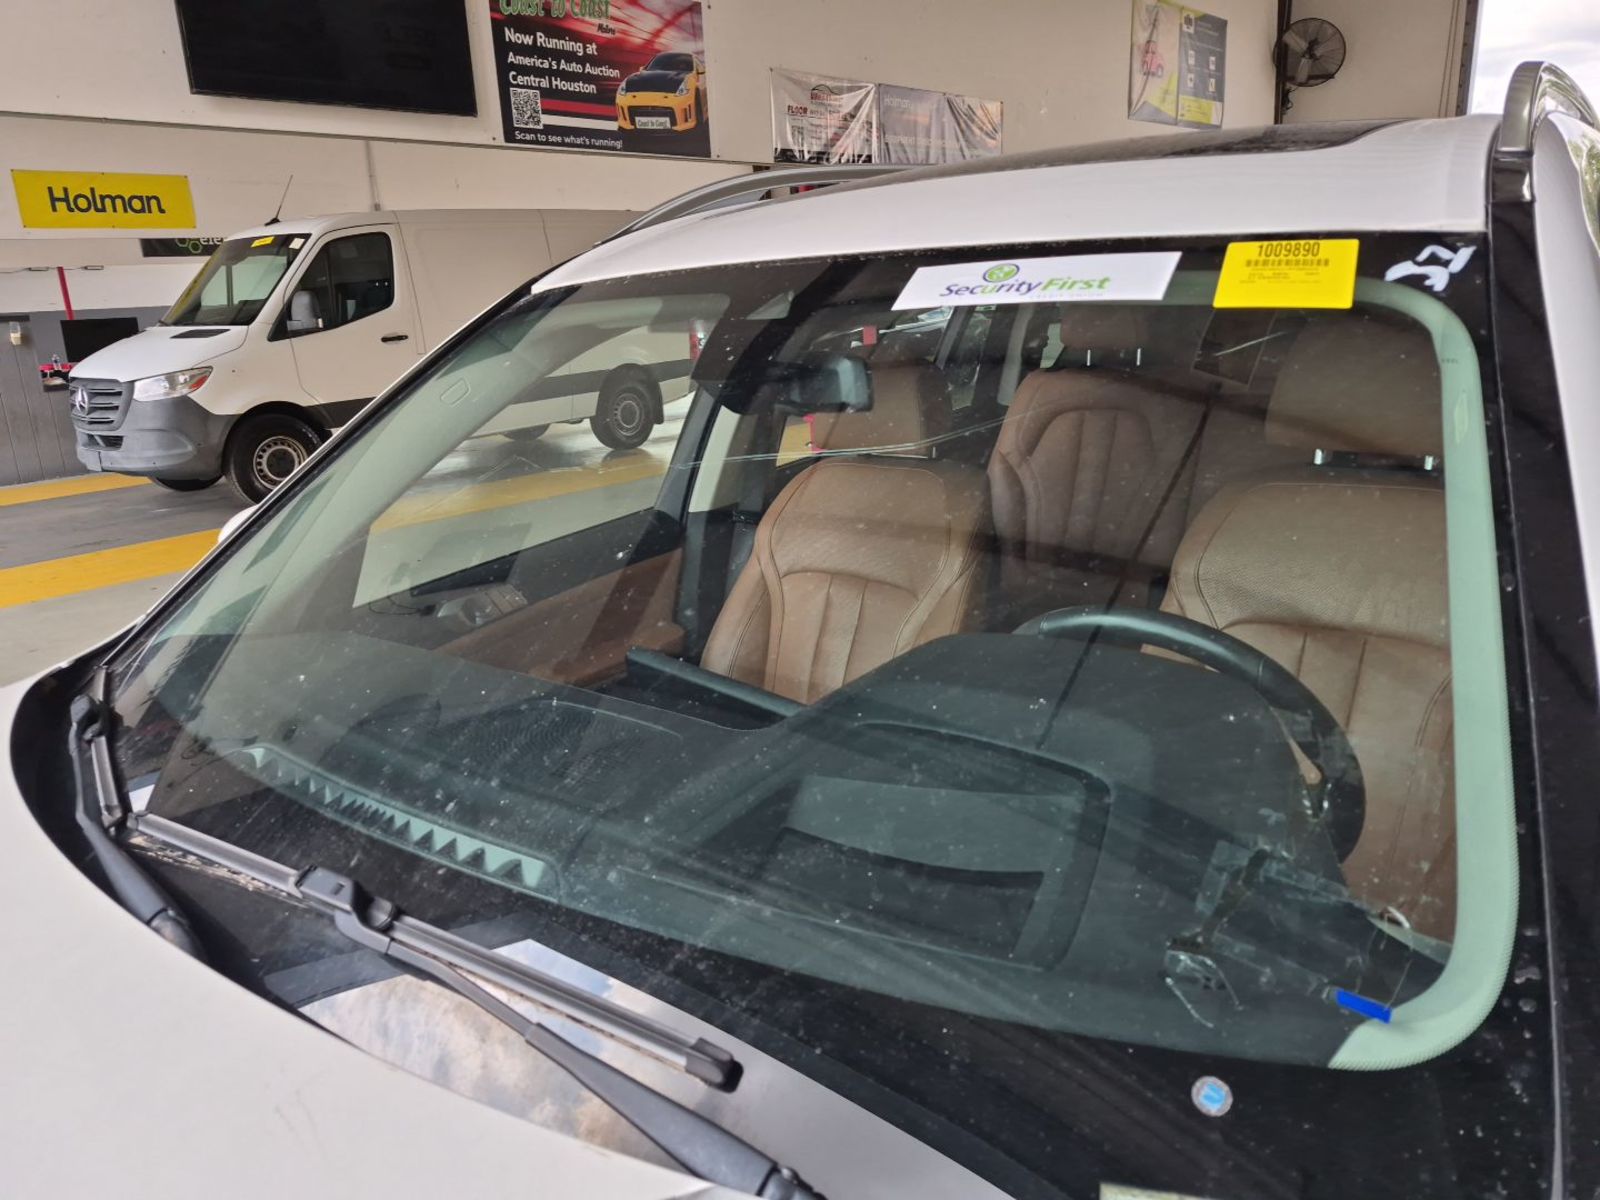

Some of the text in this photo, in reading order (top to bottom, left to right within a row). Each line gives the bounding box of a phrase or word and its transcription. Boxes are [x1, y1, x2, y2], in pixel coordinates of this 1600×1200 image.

[504, 26, 599, 57] Now Running at
[507, 51, 621, 79] America's Auto Auction
[509, 71, 598, 94] Central Houston
[514, 130, 623, 149] Scan to see what's running!
[47, 186, 166, 214] Holman
[1257, 241, 1321, 258] 1009890
